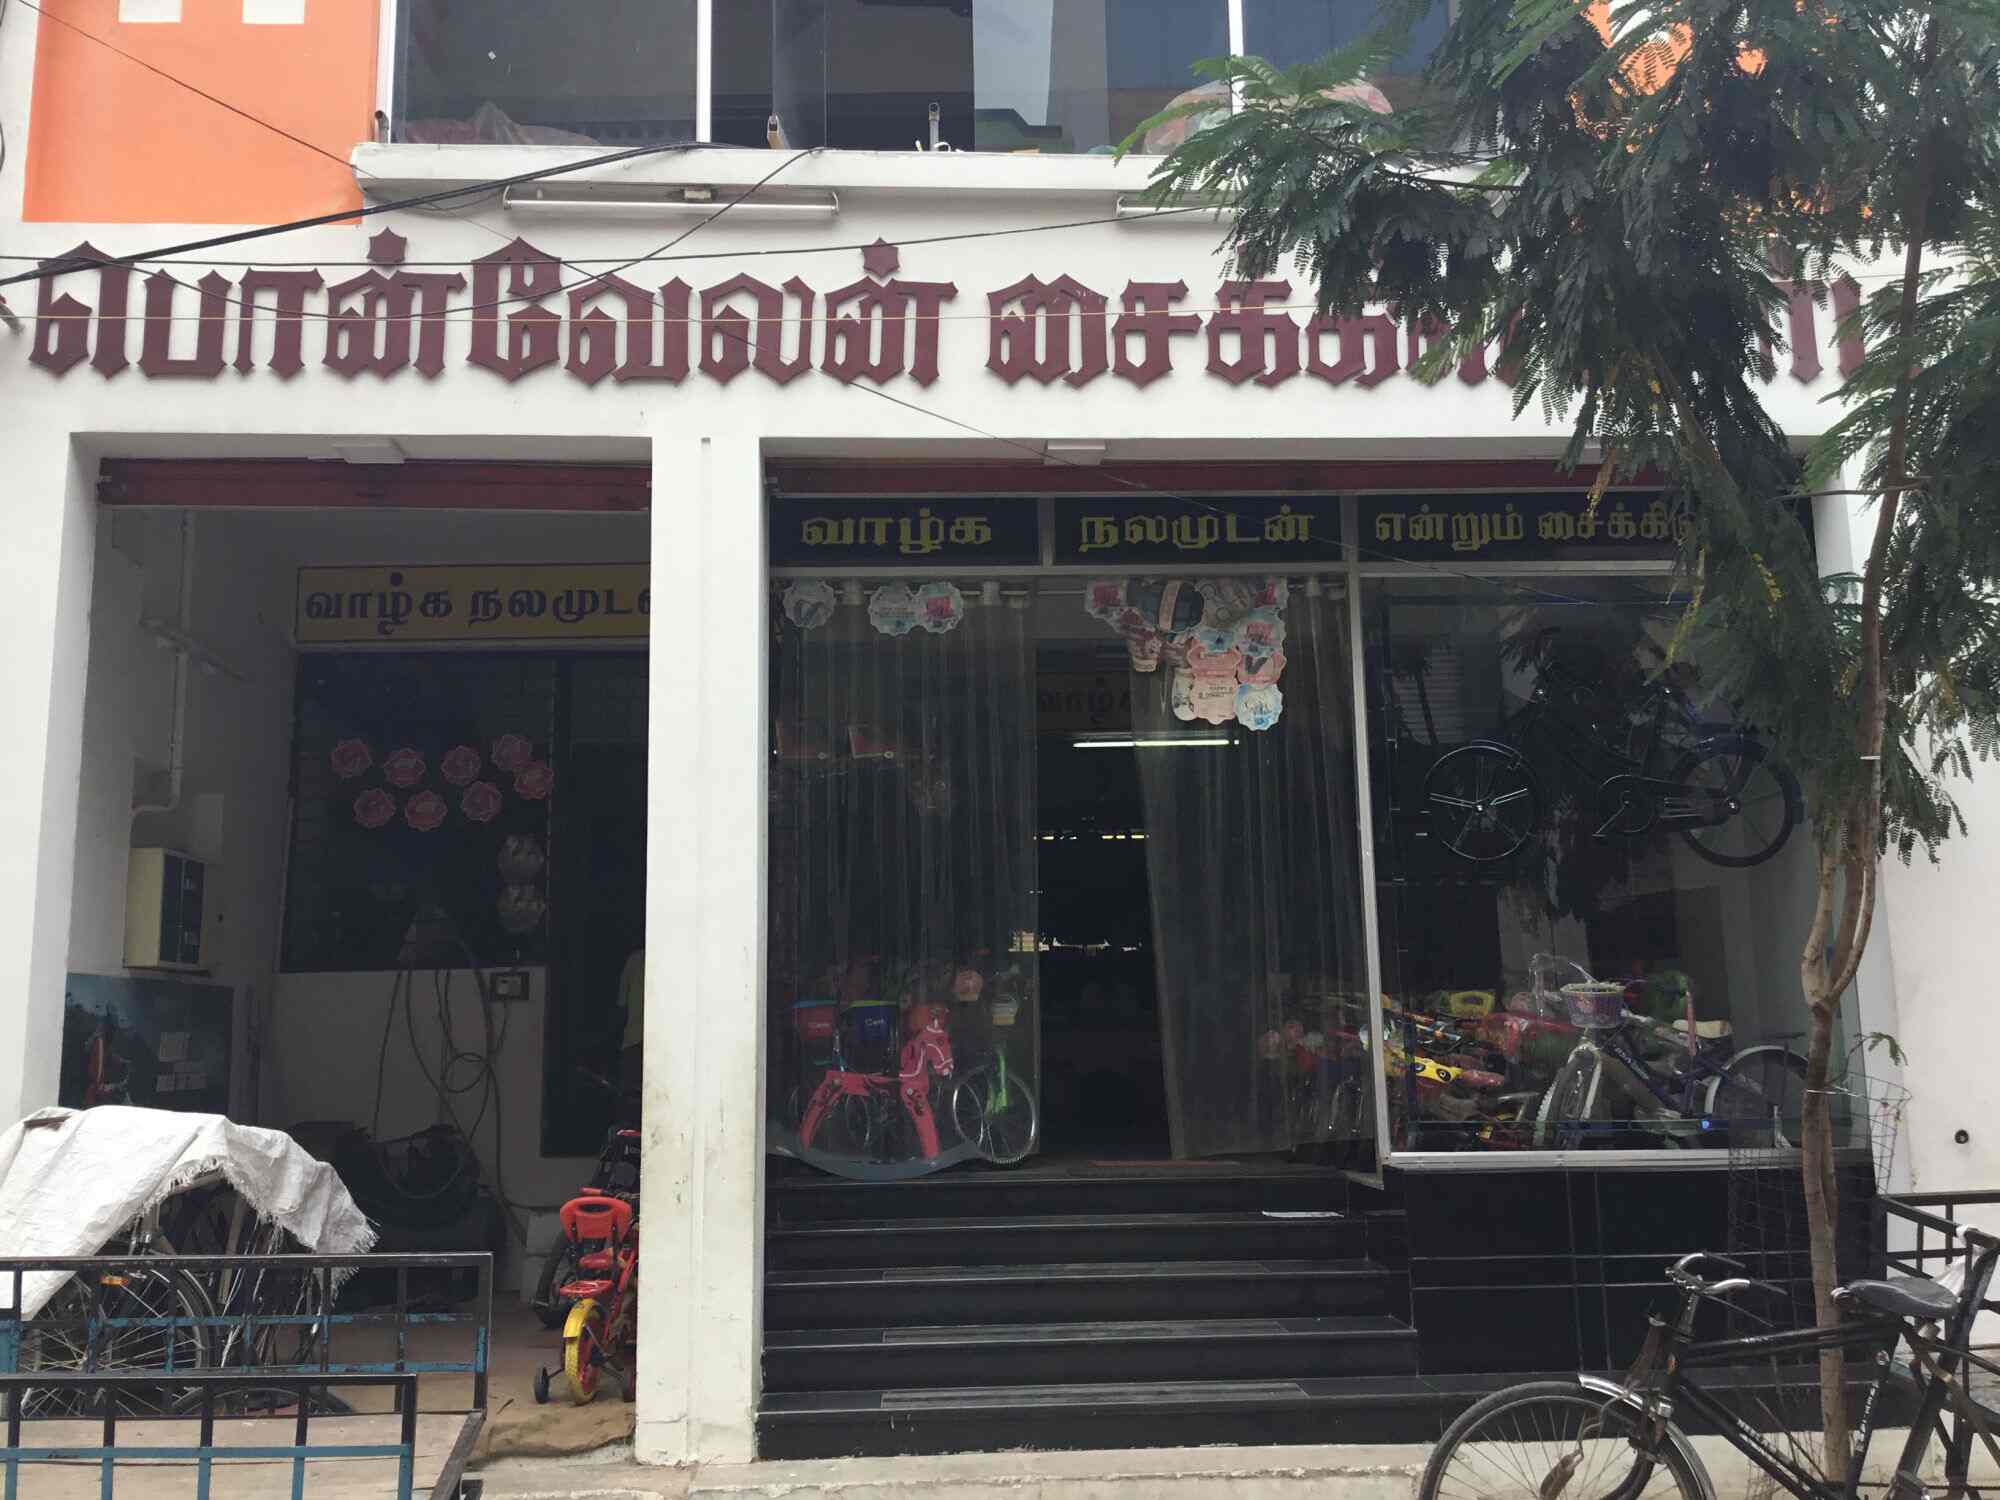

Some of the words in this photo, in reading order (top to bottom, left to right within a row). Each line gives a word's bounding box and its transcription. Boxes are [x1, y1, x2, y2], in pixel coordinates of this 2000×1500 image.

[28, 226, 960, 387] பொன்வேலன்
[801, 507, 993, 554] வாழ்க
[1078, 504, 1315, 553] நலமுடன்
[1375, 503, 1524, 551] என்றும்
[305, 571, 453, 635] வாழ்க
